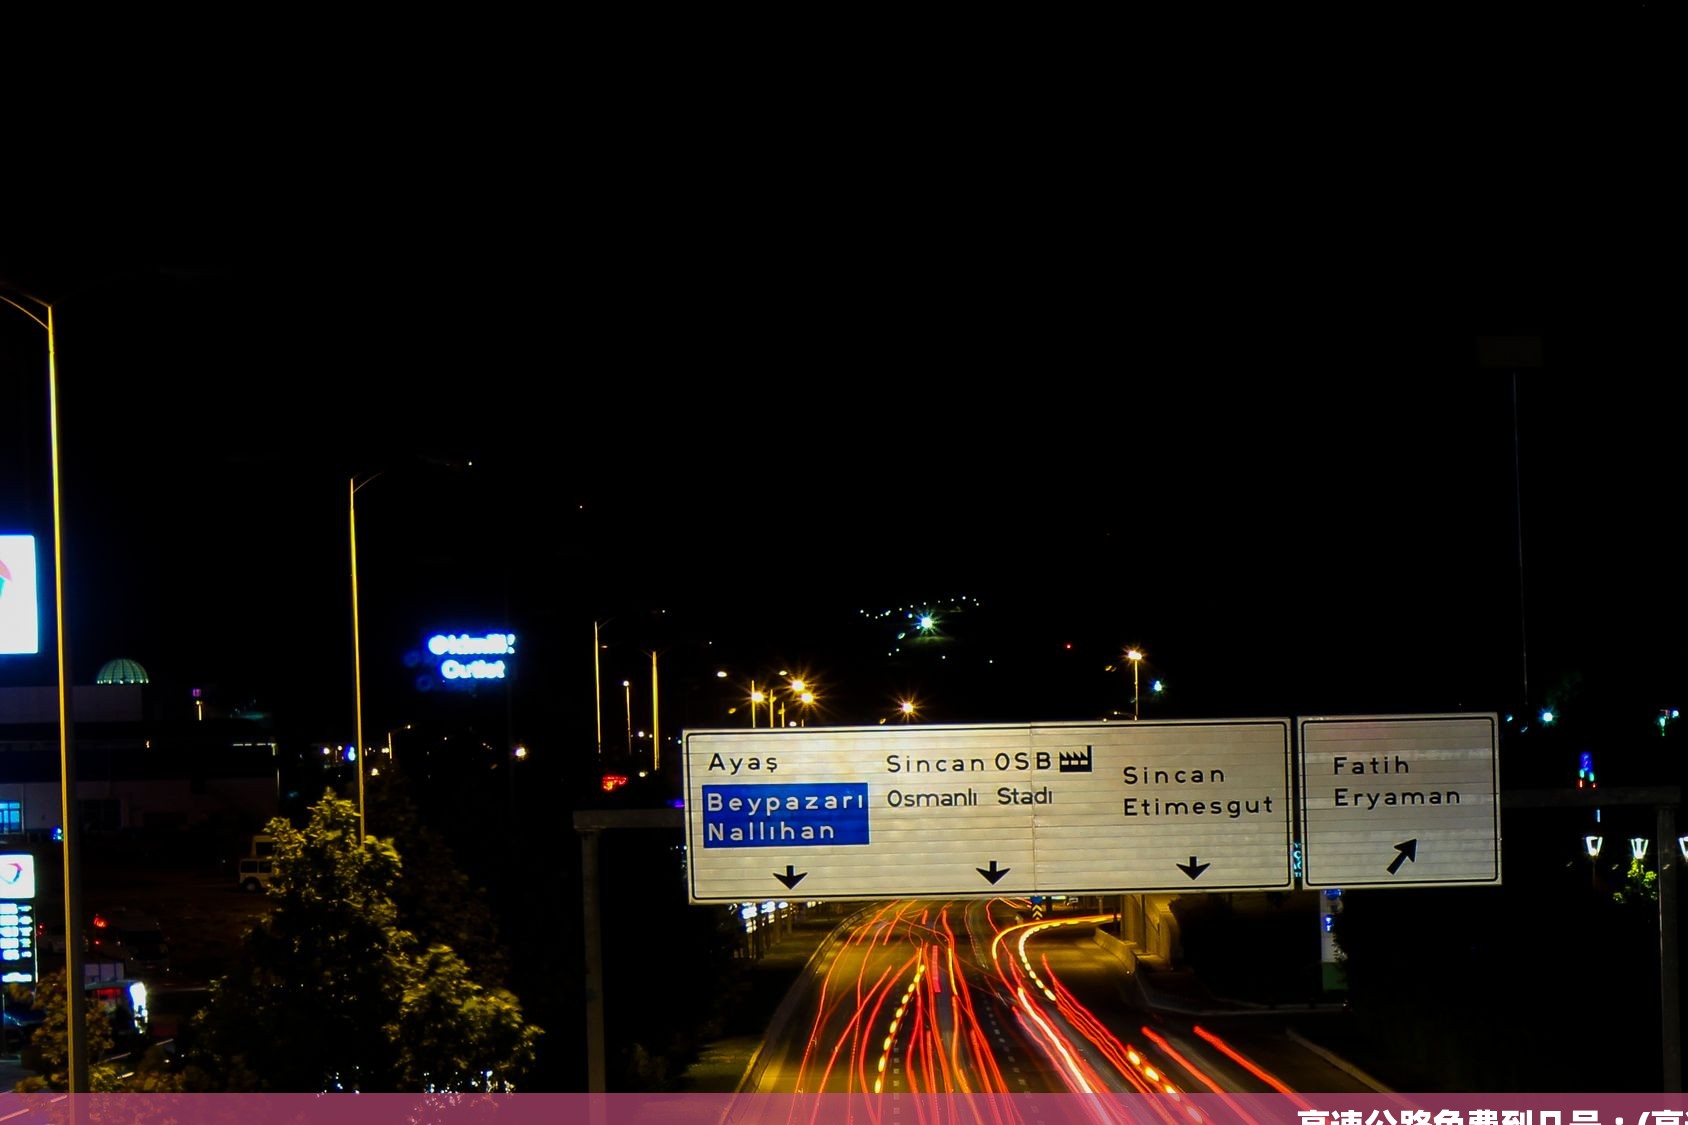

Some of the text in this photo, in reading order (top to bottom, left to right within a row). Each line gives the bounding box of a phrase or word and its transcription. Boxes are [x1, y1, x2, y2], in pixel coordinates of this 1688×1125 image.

[708, 752, 778, 775] Ayaş
[886, 751, 1052, 773] Sincan OSB
[1333, 755, 1410, 776] Fatih
[1123, 766, 1225, 785] Sincan
[707, 793, 864, 816] Beypazarı
[887, 786, 1053, 808] Osmanlı Stadı
[1123, 795, 1273, 819] Etimesgut
[1334, 788, 1461, 811] Eryaman
[708, 821, 835, 842] Nallıhan
